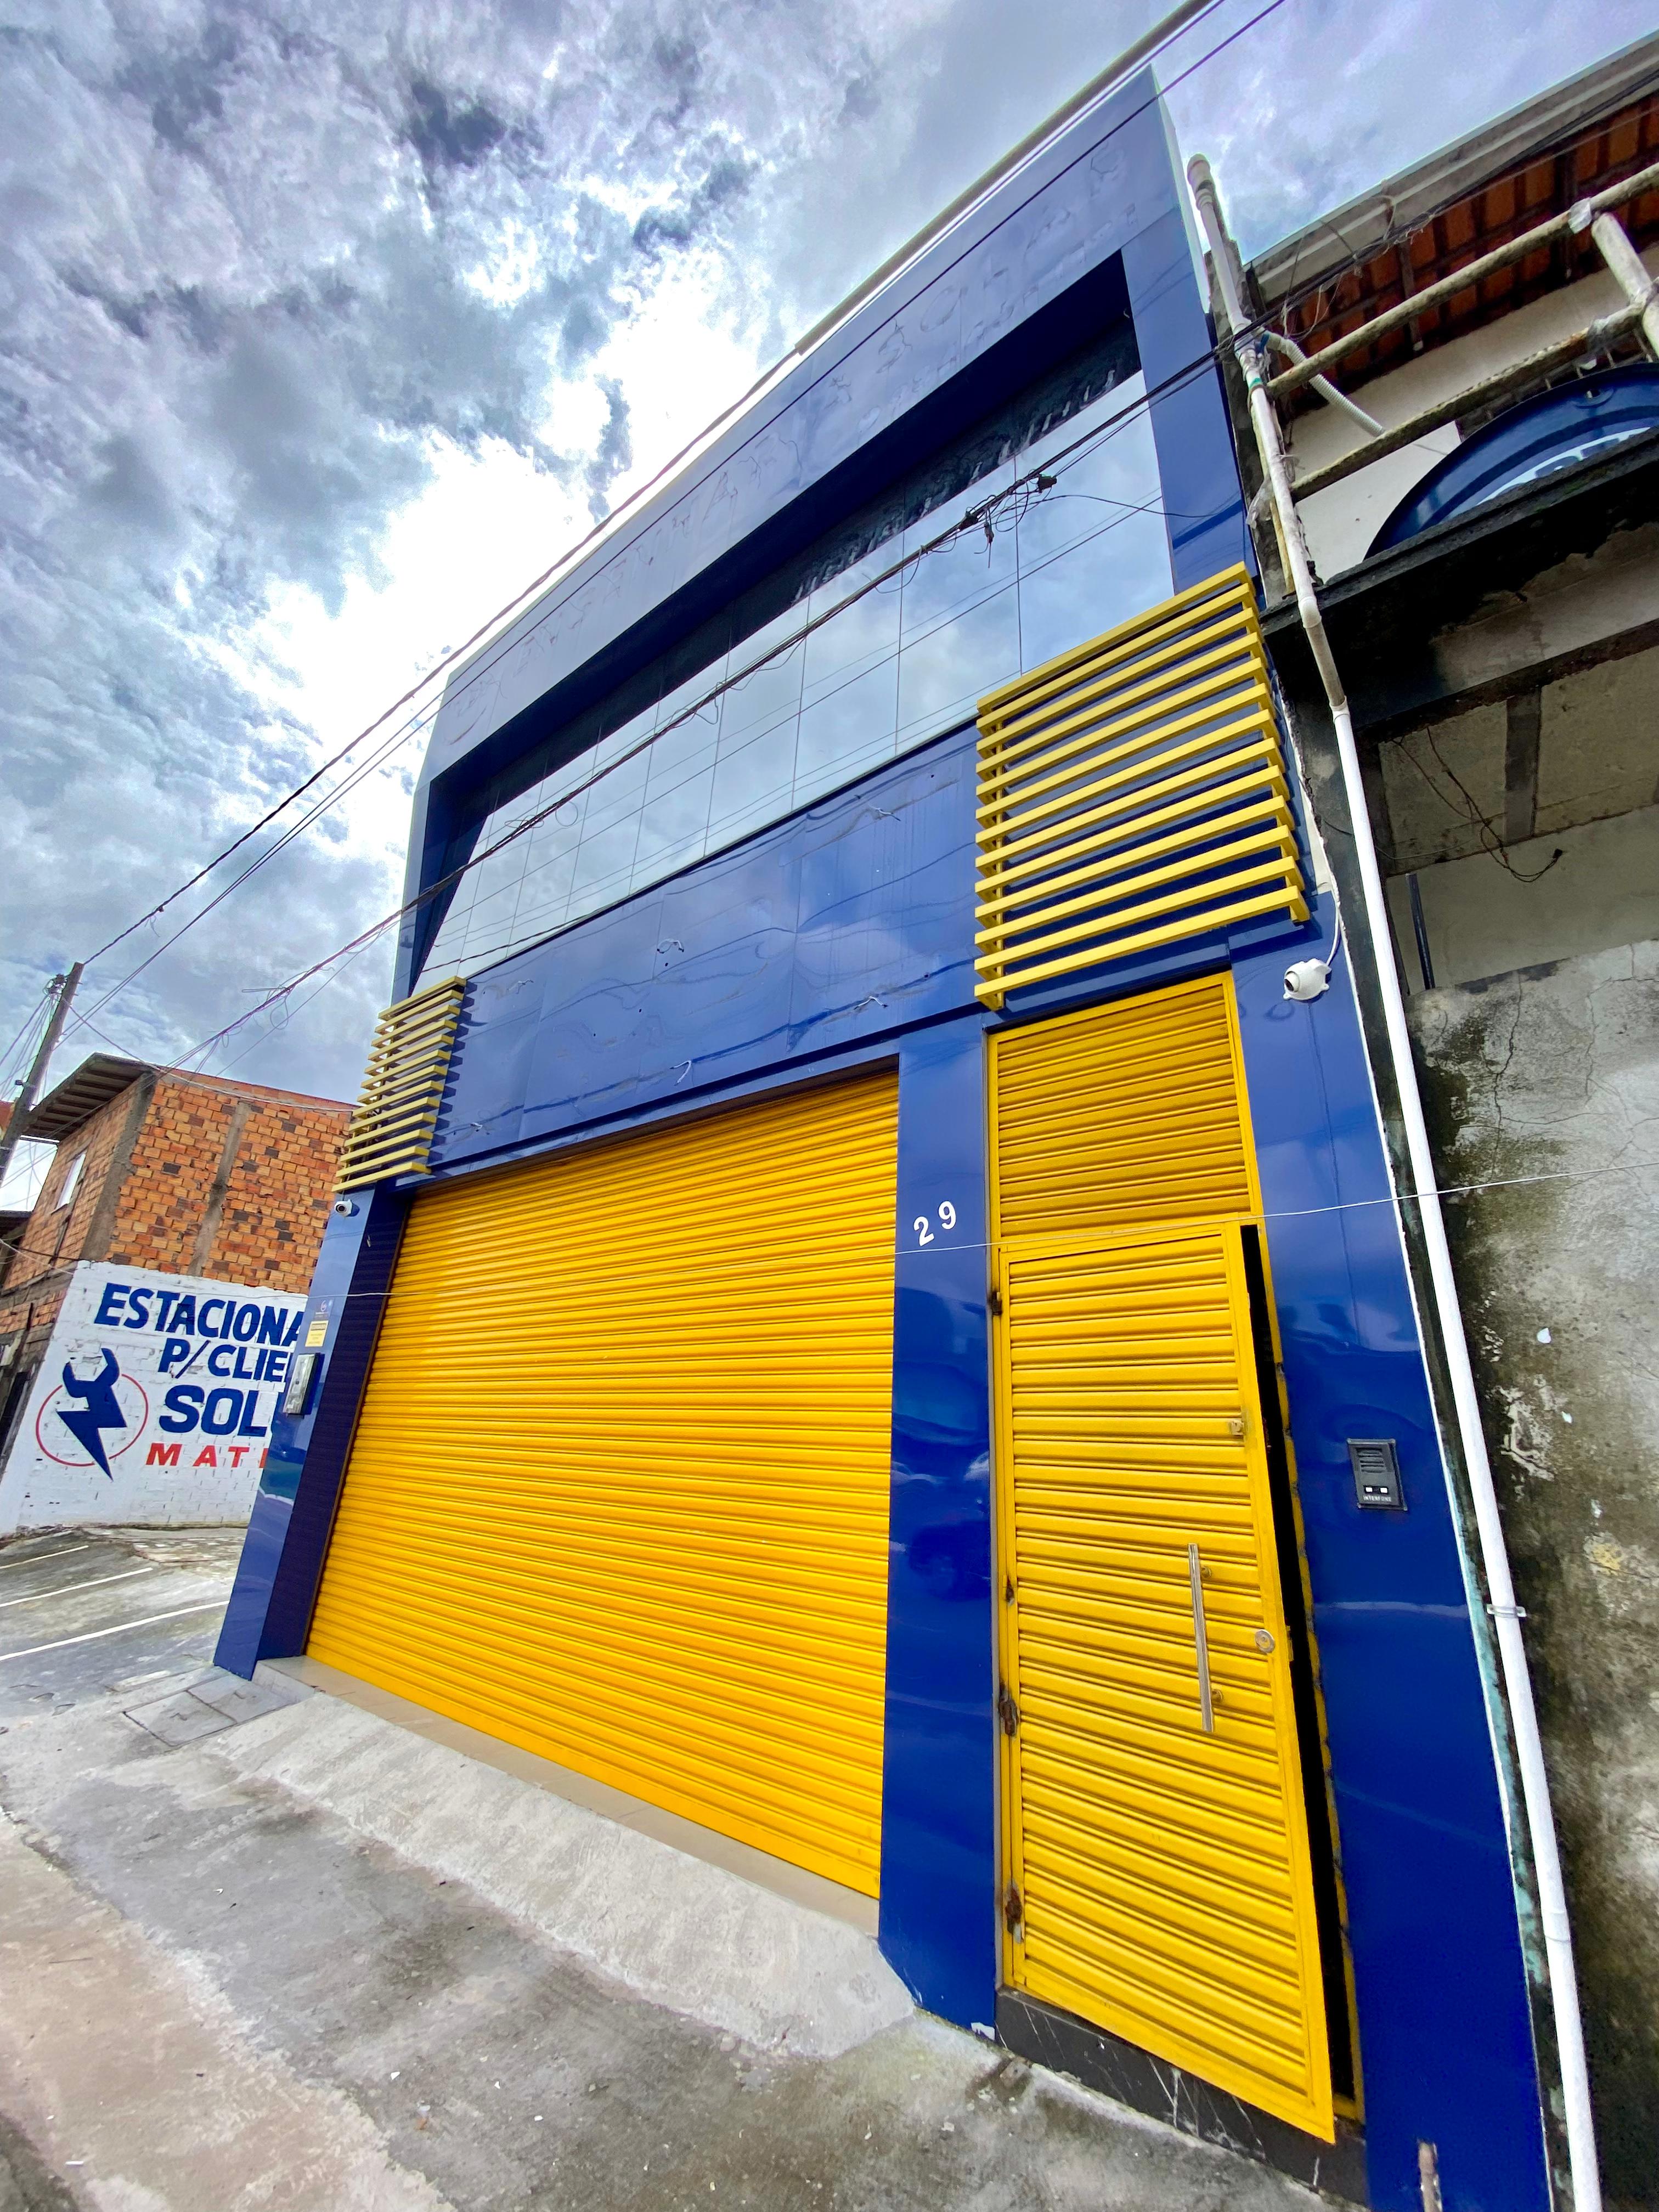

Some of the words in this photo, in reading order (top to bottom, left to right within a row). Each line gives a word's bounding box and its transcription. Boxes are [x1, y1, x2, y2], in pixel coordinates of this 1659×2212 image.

[913, 1200, 957, 1247] 29
[157, 1337, 292, 1384] P/CLIE
[158, 1384, 280, 1437] SOL
